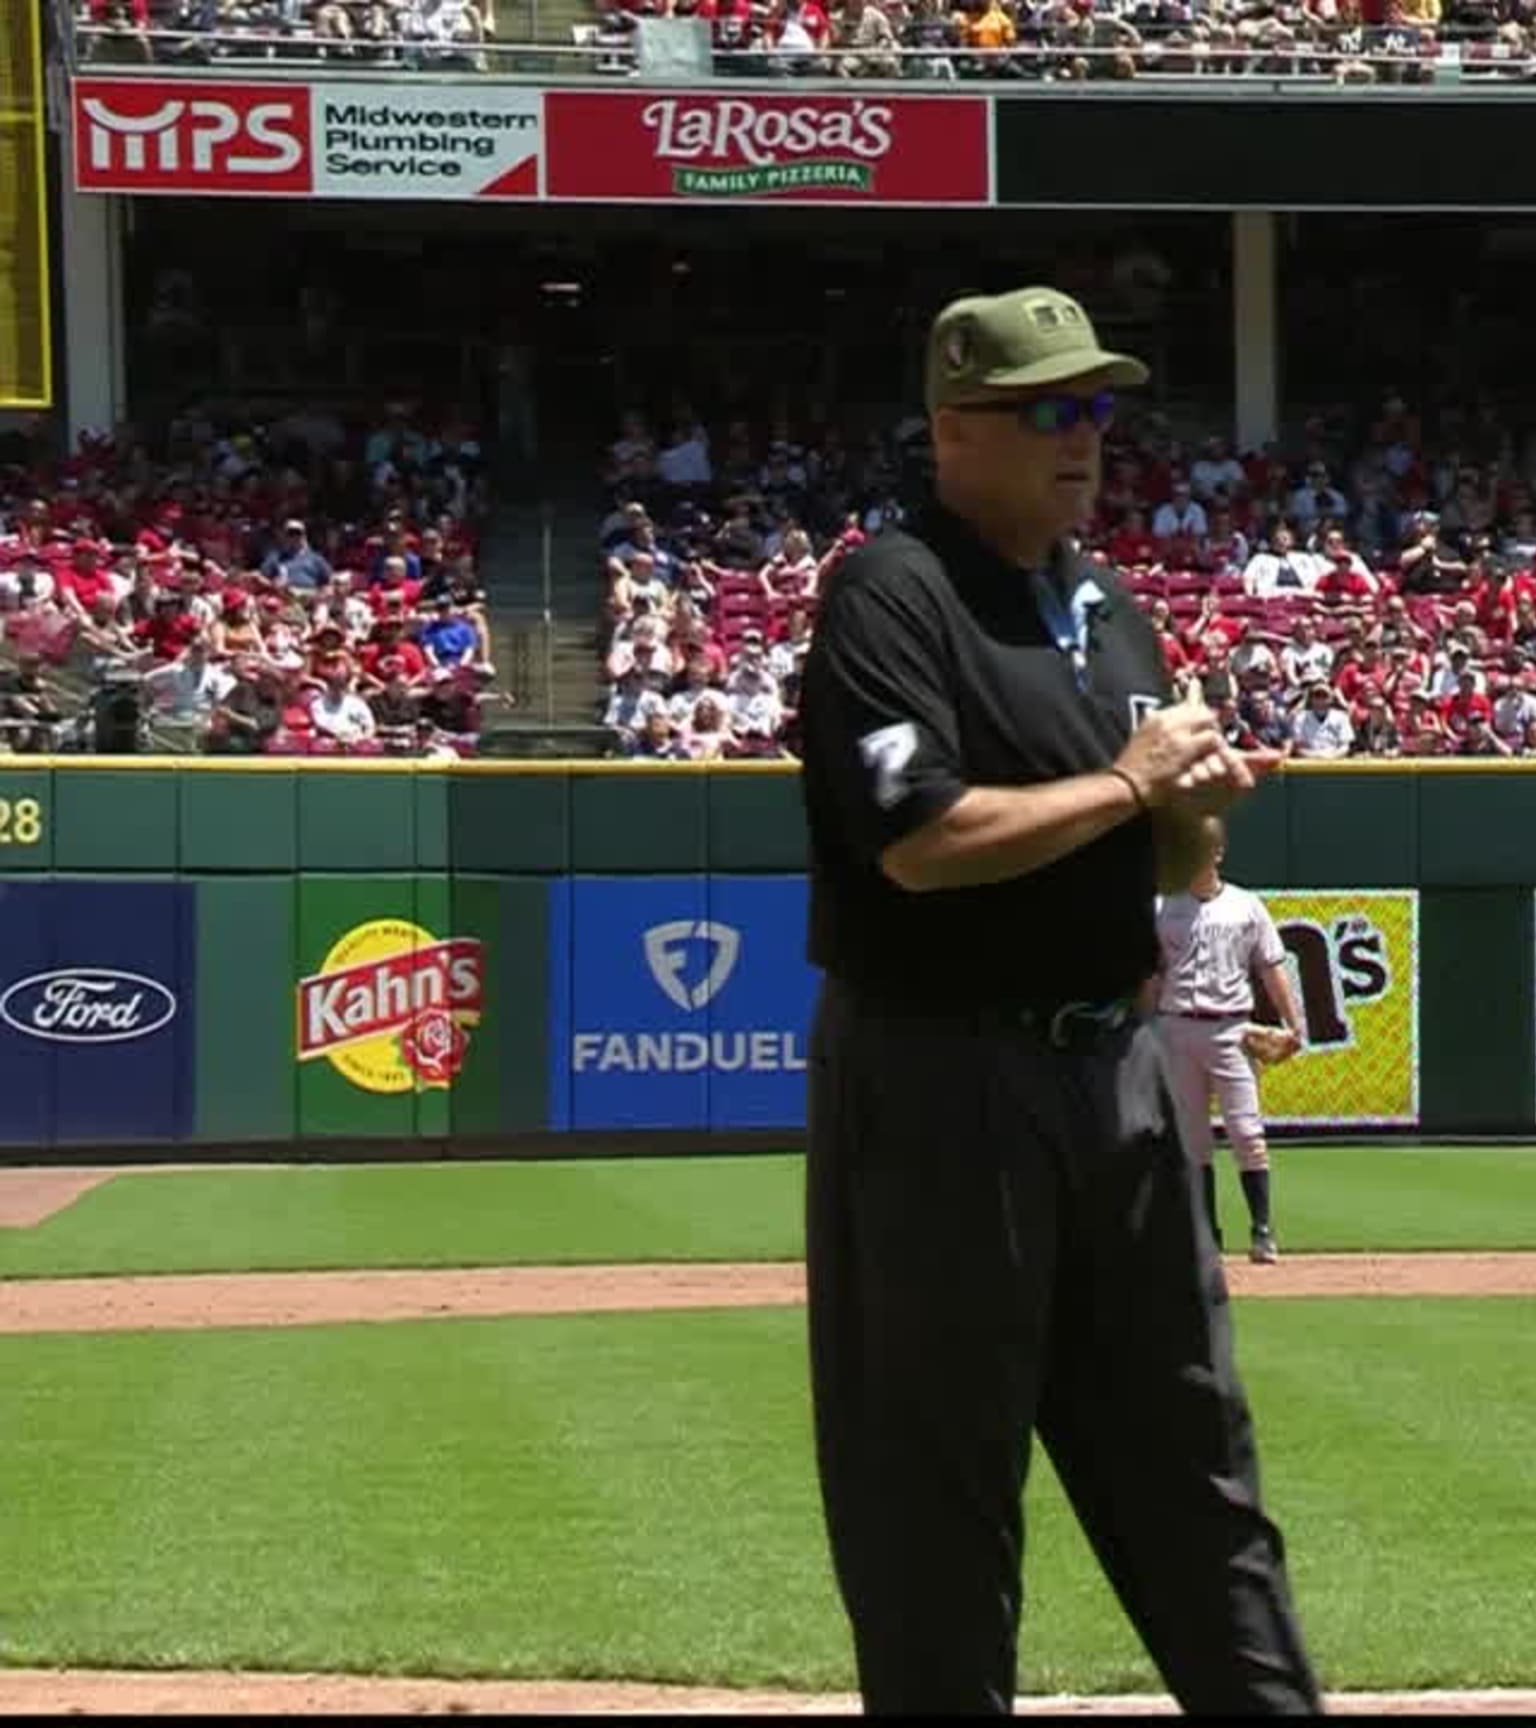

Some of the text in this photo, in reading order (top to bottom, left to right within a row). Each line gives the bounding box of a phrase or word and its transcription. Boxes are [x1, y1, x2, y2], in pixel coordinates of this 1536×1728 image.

[325, 104, 538, 129] Midwestern
[642, 99, 893, 165] LaRosa's
[325, 129, 494, 157] Plumbing
[325, 152, 461, 177] Service
[685, 165, 862, 193] FAMILY PIZZERIA
[859, 722, 918, 808] 7
[34, 978, 142, 1029] Ford
[308, 952, 481, 1044] Kahn's
[573, 1031, 807, 1072] FANDUEL
